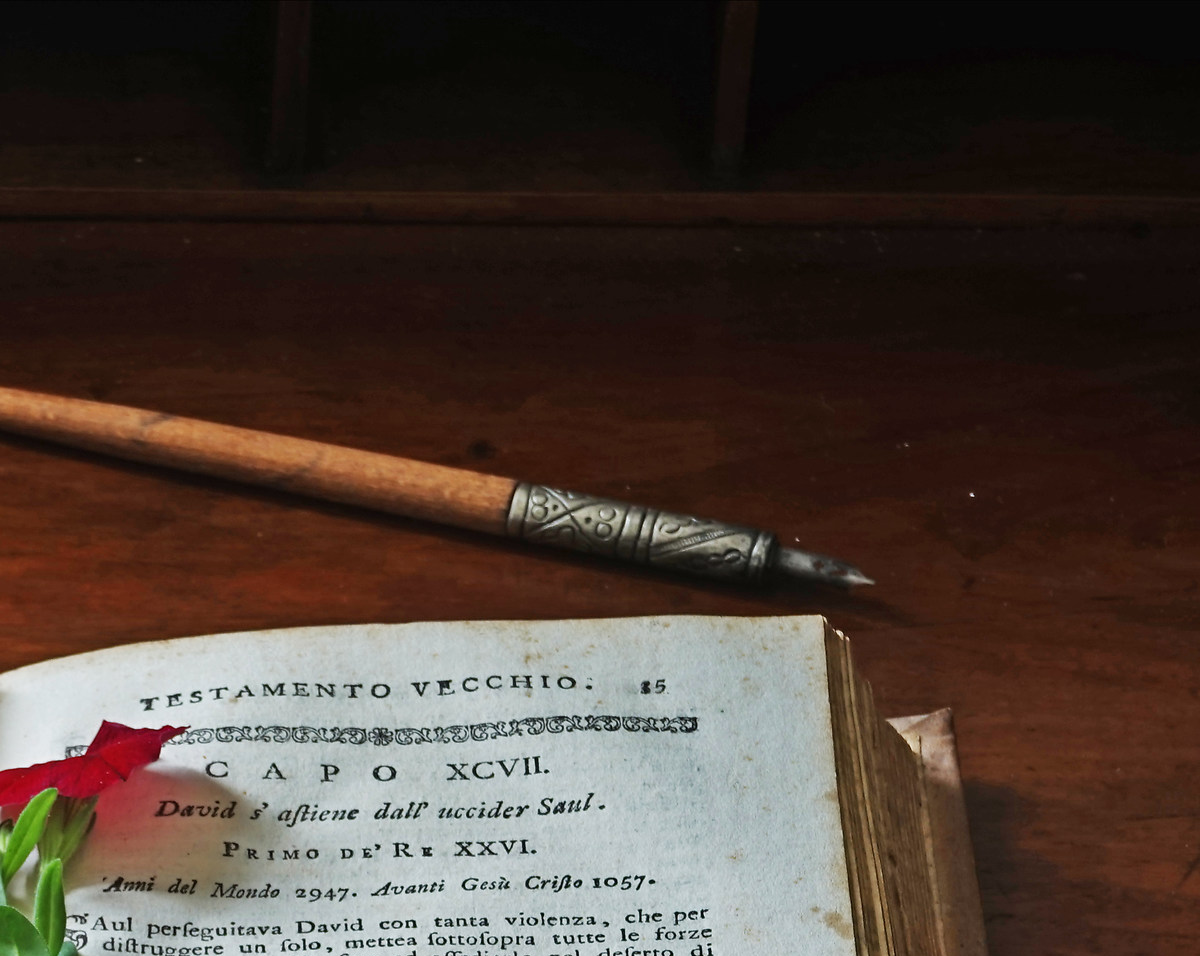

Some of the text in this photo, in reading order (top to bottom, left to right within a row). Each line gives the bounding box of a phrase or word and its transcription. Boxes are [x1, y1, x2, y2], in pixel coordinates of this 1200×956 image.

[140, 683, 391, 711] TESTAMENTO
[205, 756, 549, 783] CAPO XCVII.
[154, 801, 237, 818] David
[438, 801, 529, 819] uccider
[454, 839, 537, 857] XXVI.
[103, 876, 156, 892] Anni
[168, 878, 198, 895] del
[210, 882, 280, 898] Mondo
[296, 888, 357, 902] 2947.
[371, 880, 445, 896] Avanti
[461, 877, 510, 891] Gesù
[593, 875, 656, 891] 1057.
[296, 909, 709, 934] David tanta per
[553, 927, 712, 945] tutte forze
